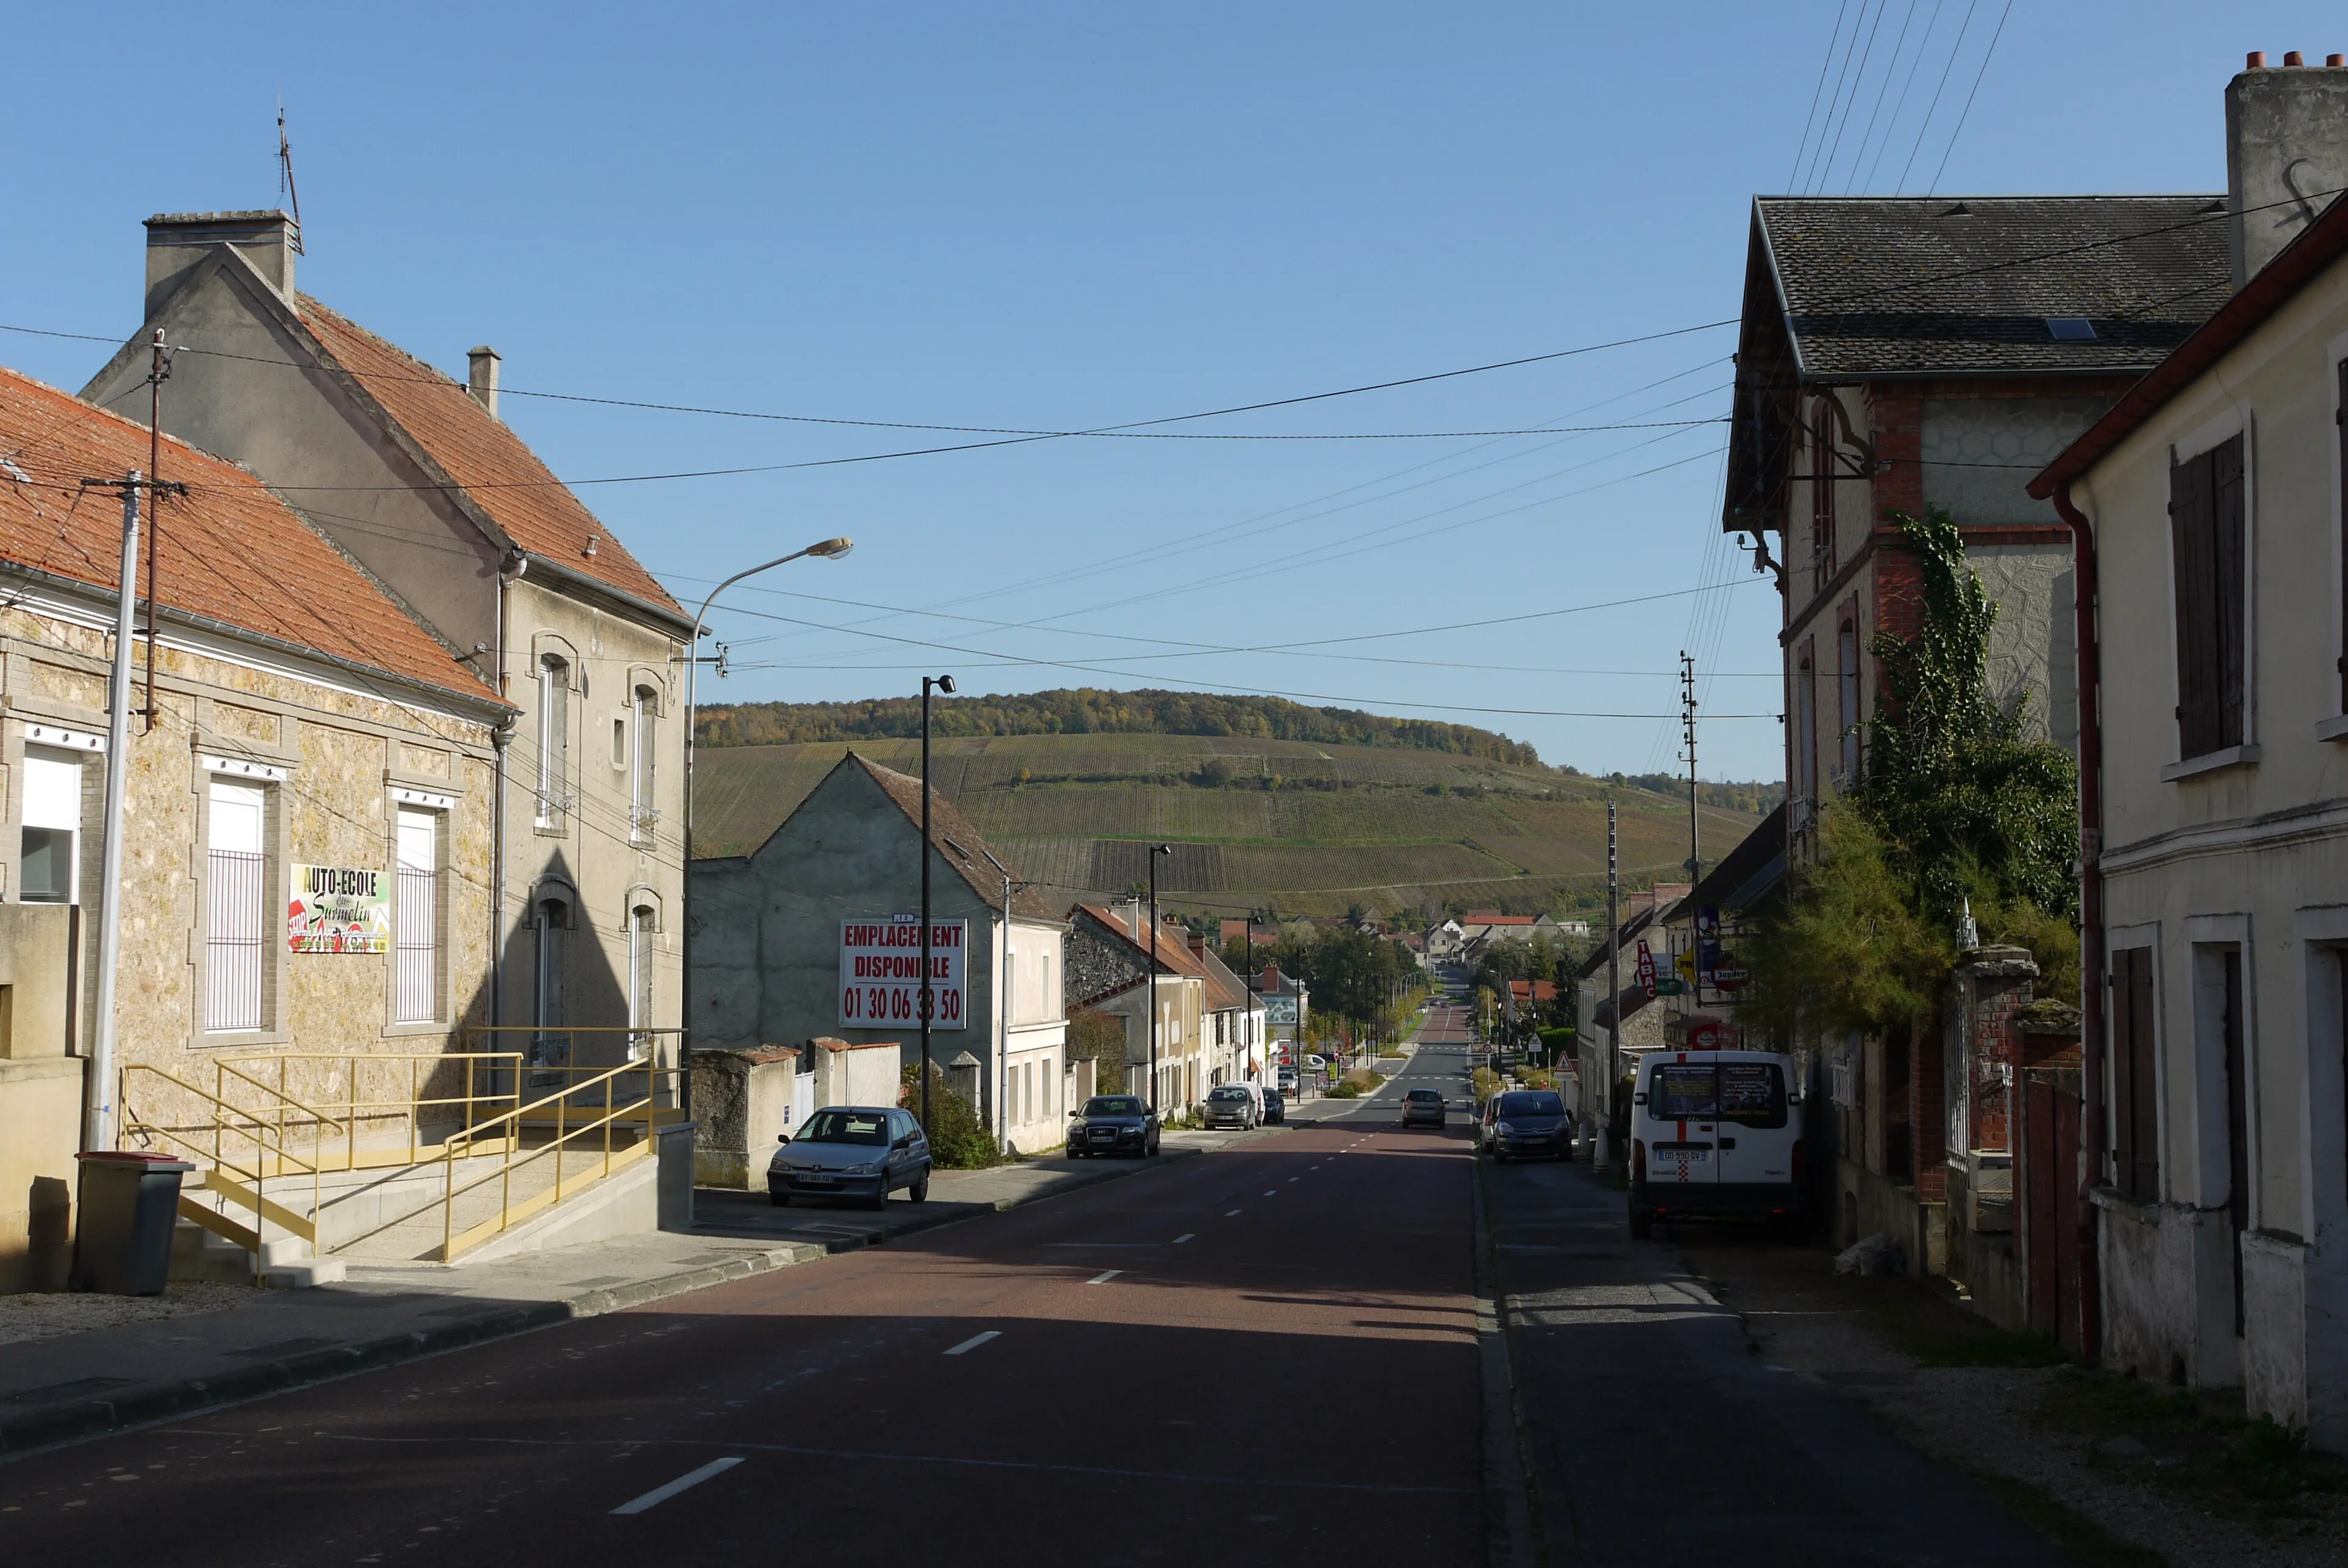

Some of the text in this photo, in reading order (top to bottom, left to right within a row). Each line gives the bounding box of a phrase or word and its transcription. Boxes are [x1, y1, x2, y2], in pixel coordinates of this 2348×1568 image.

[303, 867, 376, 897] AUTO-ECOLE
[309, 893, 370, 924] Surmelin
[289, 912, 306, 940] STOP
[1639, 941, 1655, 997] TABAC
[1717, 970, 1746, 979] Jupiler
[844, 987, 861, 1018] 01
[869, 988, 887, 1019] 30
[892, 988, 910, 1020] 06
[941, 989, 959, 1020] 50
